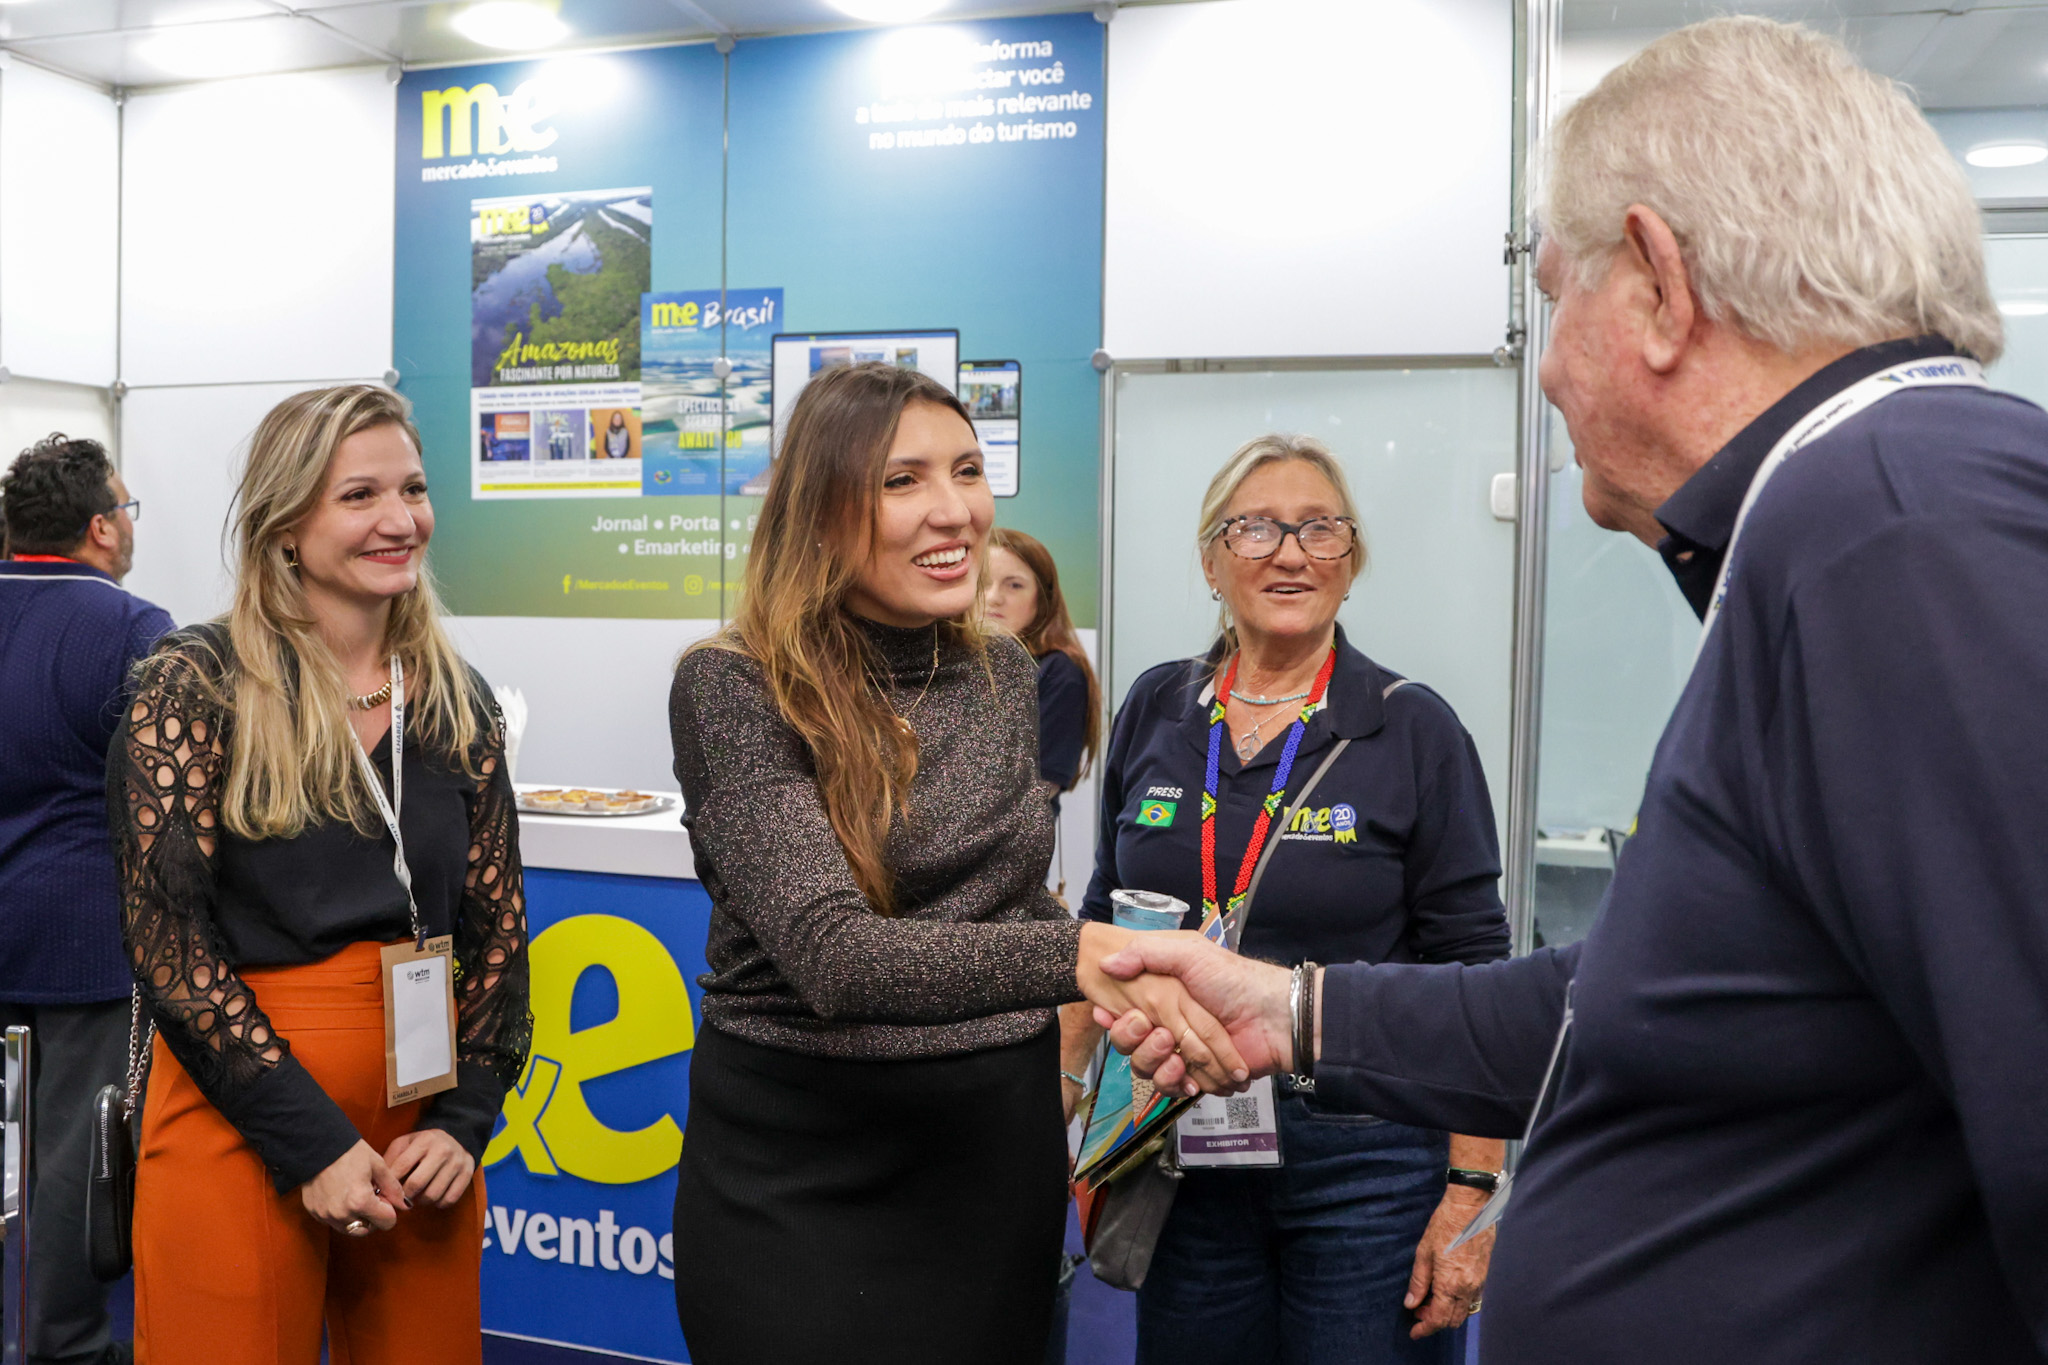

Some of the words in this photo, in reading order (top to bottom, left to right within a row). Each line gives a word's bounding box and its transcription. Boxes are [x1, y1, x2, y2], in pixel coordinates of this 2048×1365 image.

[1018, 61, 1065, 86] você
[997, 91, 1093, 115] relevante
[869, 132, 895, 150] no
[968, 122, 995, 143] do
[997, 119, 1077, 142] turismo
[702, 296, 775, 331] Brasil
[495, 332, 620, 371] Amazonas
[500, 366, 554, 382] FASCINANTE
[554, 365, 574, 380] POR
[574, 363, 620, 380] NATUREZA
[678, 431, 715, 449] AWAIT
[718, 430, 743, 449] OU
[592, 515, 648, 532] Jornal
[670, 515, 722, 532] Porta
[634, 539, 737, 560] Emarketing
[1146, 786, 1184, 799] PRESS
[1334, 808, 1351, 821] 20
[1281, 833, 1334, 841] ercado&eventos
[435, 940, 450, 949] wtm
[414, 968, 430, 978] wtm
[1206, 1138, 1250, 1148] EXHIBITOR
